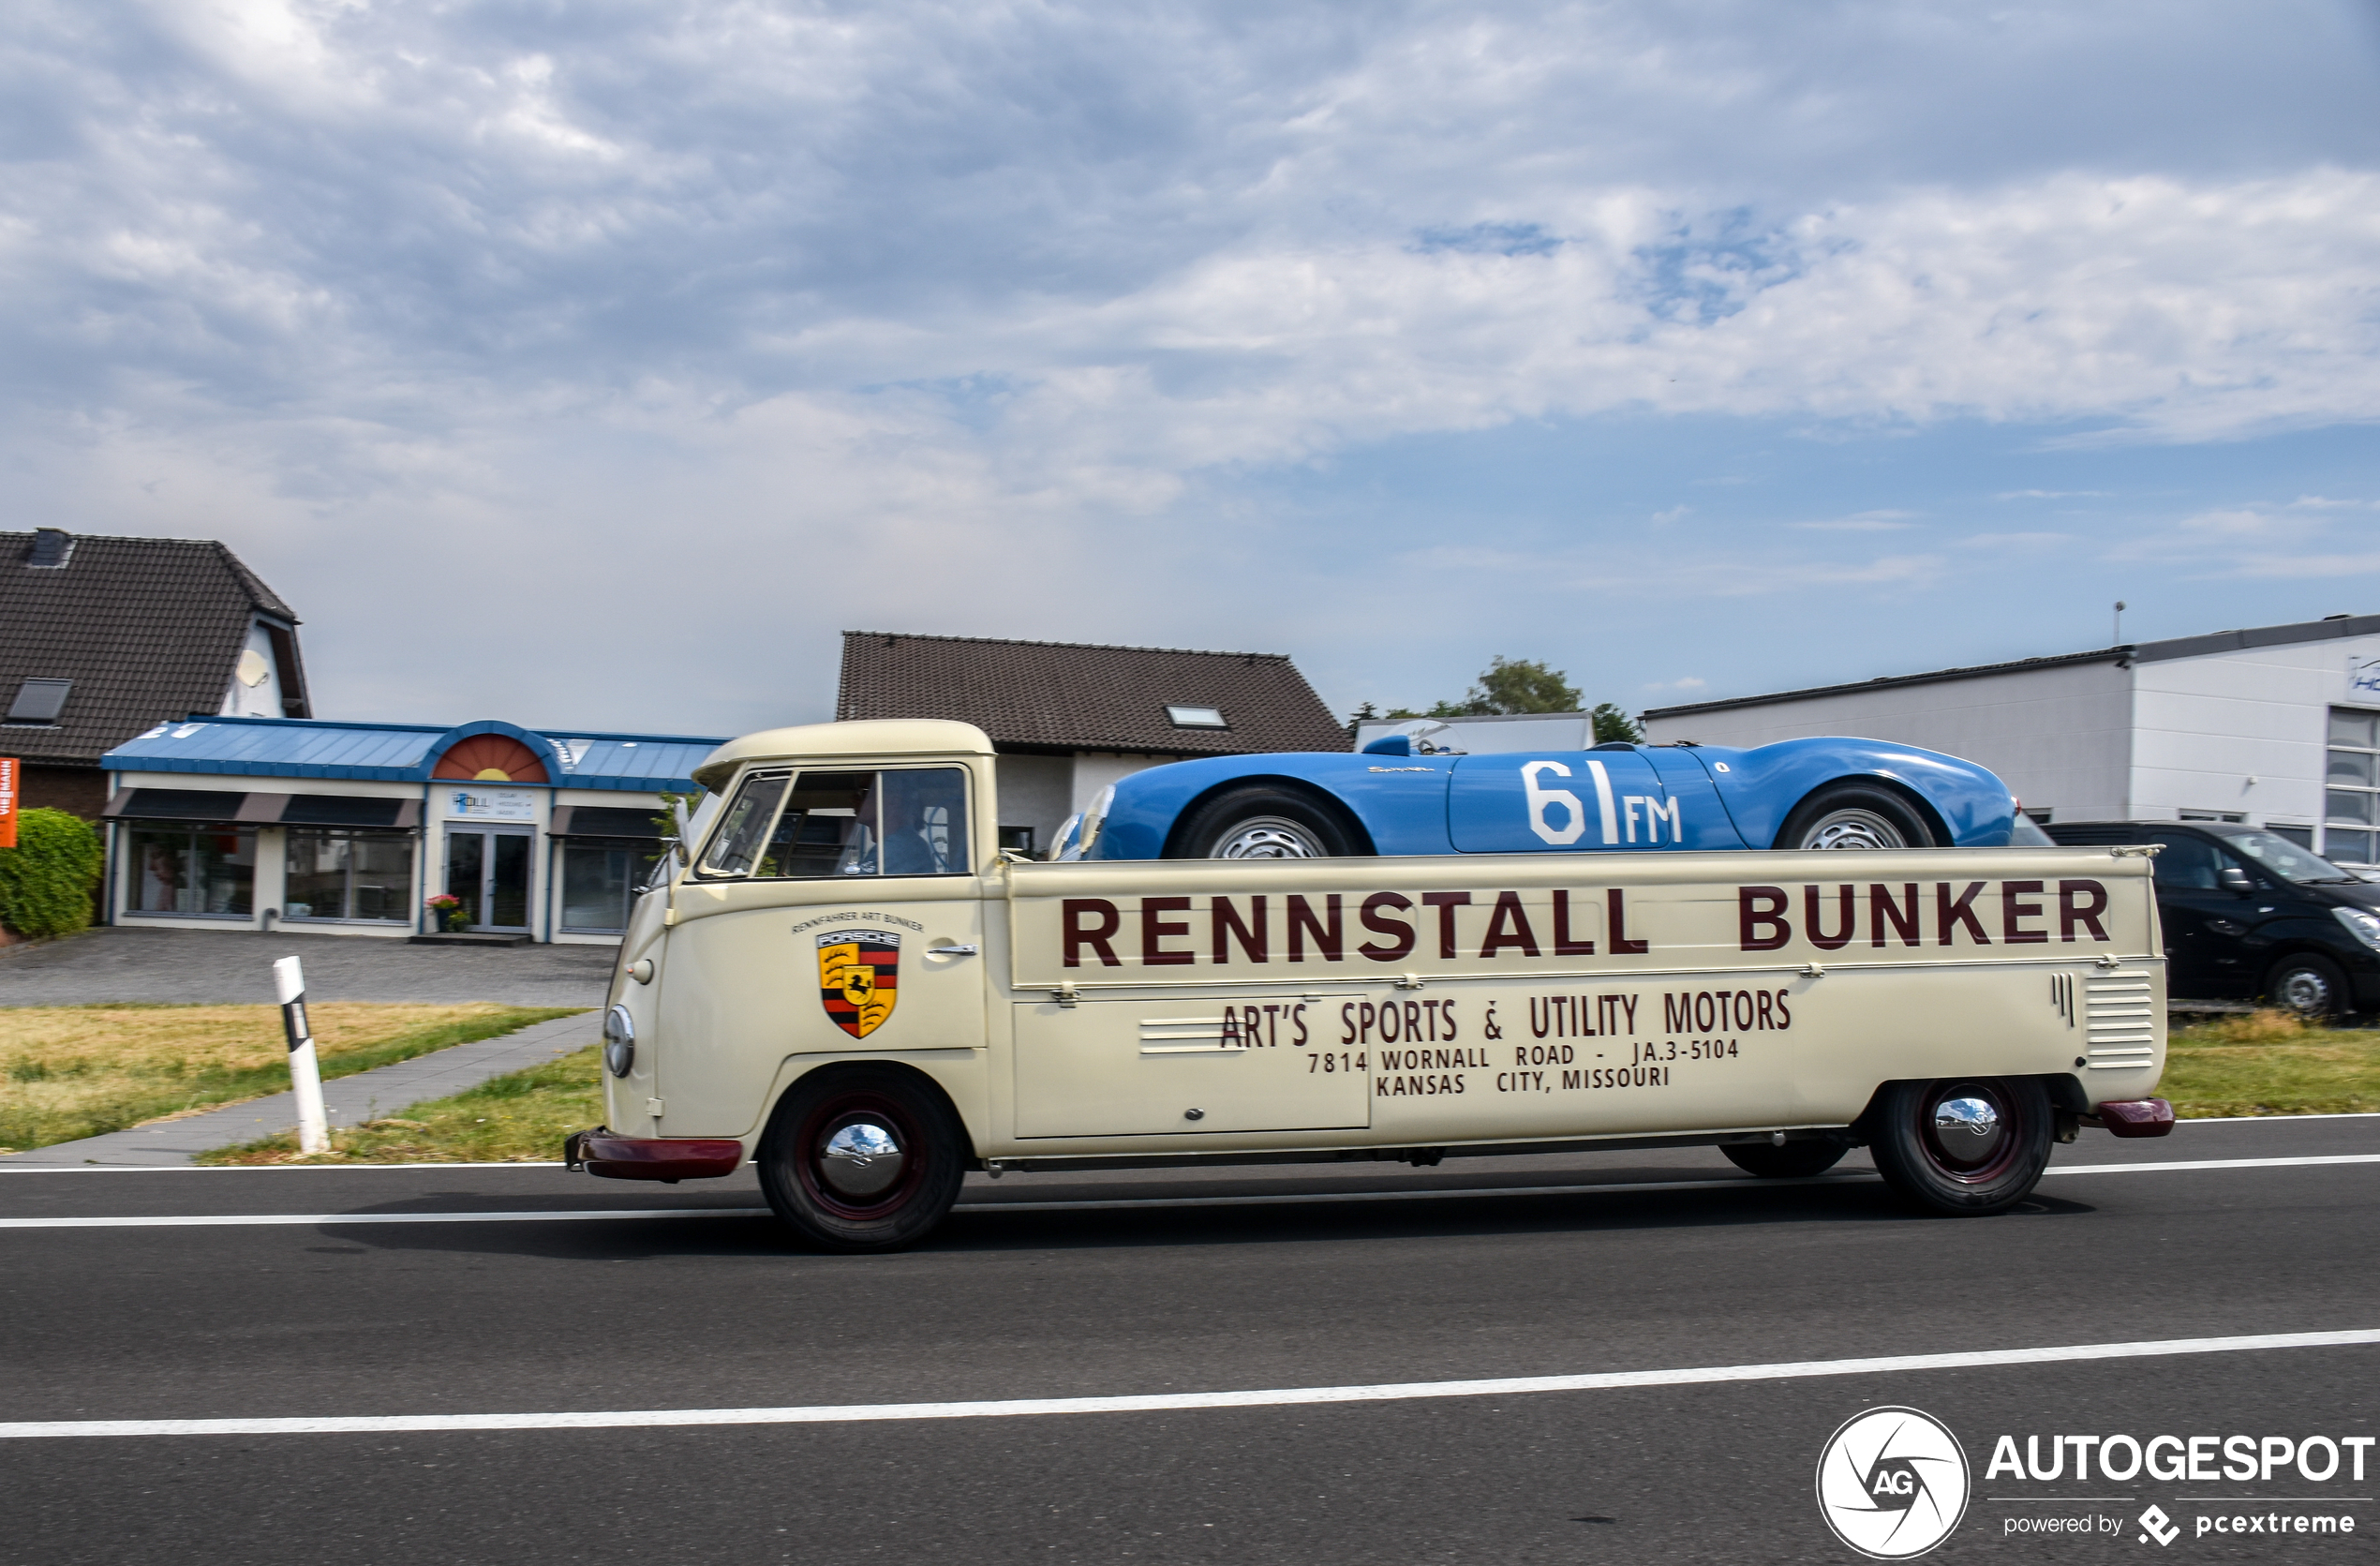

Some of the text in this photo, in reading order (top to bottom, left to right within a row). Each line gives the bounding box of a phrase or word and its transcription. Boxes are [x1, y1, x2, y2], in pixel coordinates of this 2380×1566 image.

[0, 760, 14, 815] VIEMANN
[1520, 760, 1619, 844] 61
[793, 912, 924, 934] RENNFAHRER ART BUNKER
[818, 931, 900, 947] PORSCHE
[1063, 879, 2110, 967] RENNSTALL BUNKER
[1221, 1003, 1308, 1048] ART'S
[1342, 999, 1457, 1045] SPORTS
[1530, 993, 1639, 1038] UTILITY
[1663, 989, 1791, 1034] MOTORS
[1308, 1051, 1368, 1073] 7814
[1381, 1048, 1490, 1070] WORNALL
[1516, 1045, 1574, 1066] ROAD
[1631, 1039, 1739, 1066] JA.3-5104
[1376, 1066, 1670, 1096] KANSAS CITY, MISSOURI
